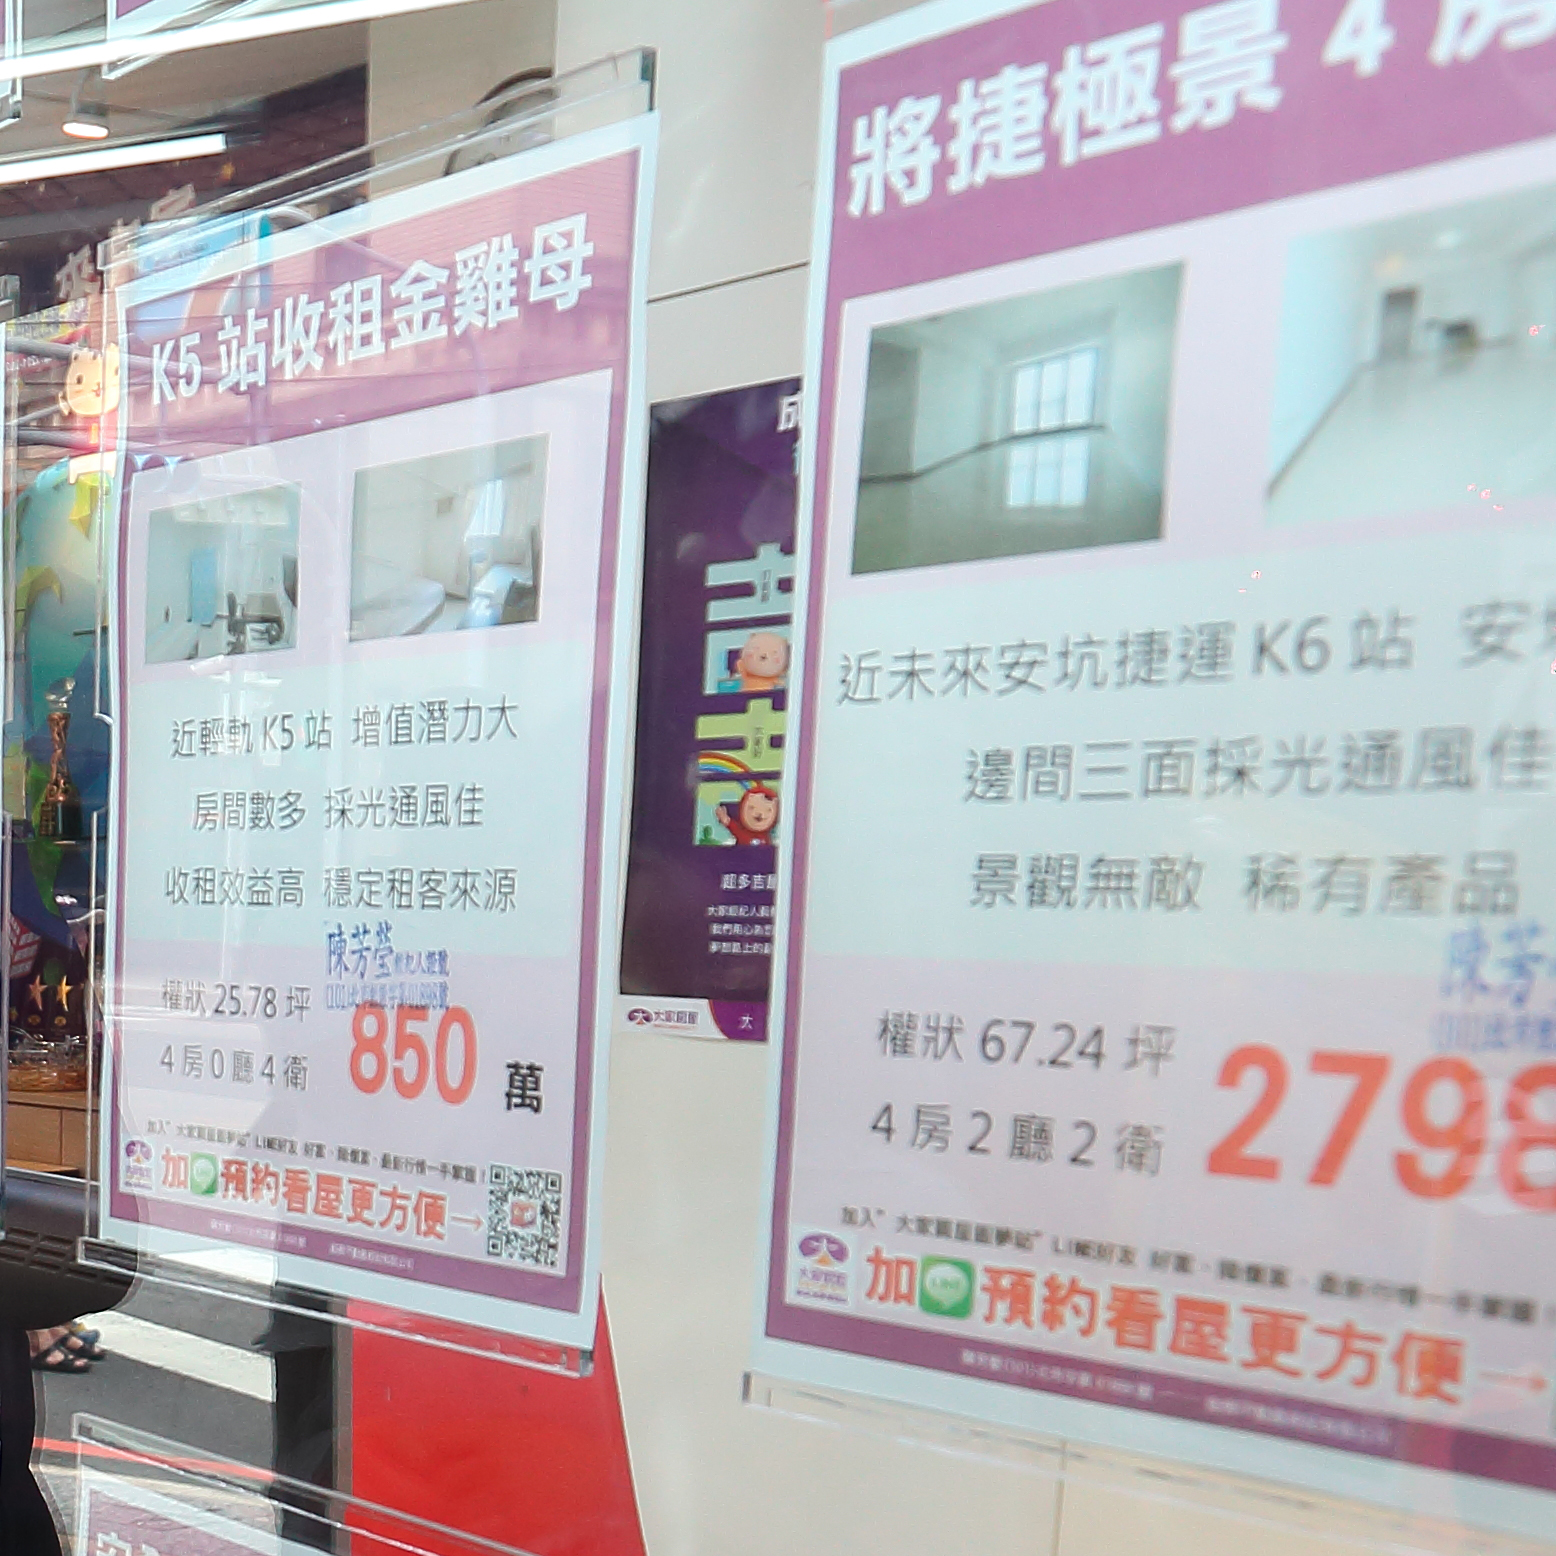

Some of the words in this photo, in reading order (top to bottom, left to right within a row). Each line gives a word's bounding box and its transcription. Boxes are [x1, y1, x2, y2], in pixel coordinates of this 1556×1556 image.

[351, 696, 519, 749] 增值潛力大
[962, 726, 1556, 804] 邊間三面採光通風佳
[193, 789, 307, 831] 房間數多
[323, 784, 486, 831] 採光通風佳
[164, 867, 305, 909] 收租效益高
[323, 866, 517, 913] 穩定租客來源
[969, 853, 1203, 913] 景觀無敵
[1242, 851, 1521, 917] 稀有產品
[350, 1000, 477, 1106] 850
[504, 1060, 545, 1115] 萬
[162, 1147, 189, 1190] 加
[221, 1157, 448, 1241] 預約看屋更方便
